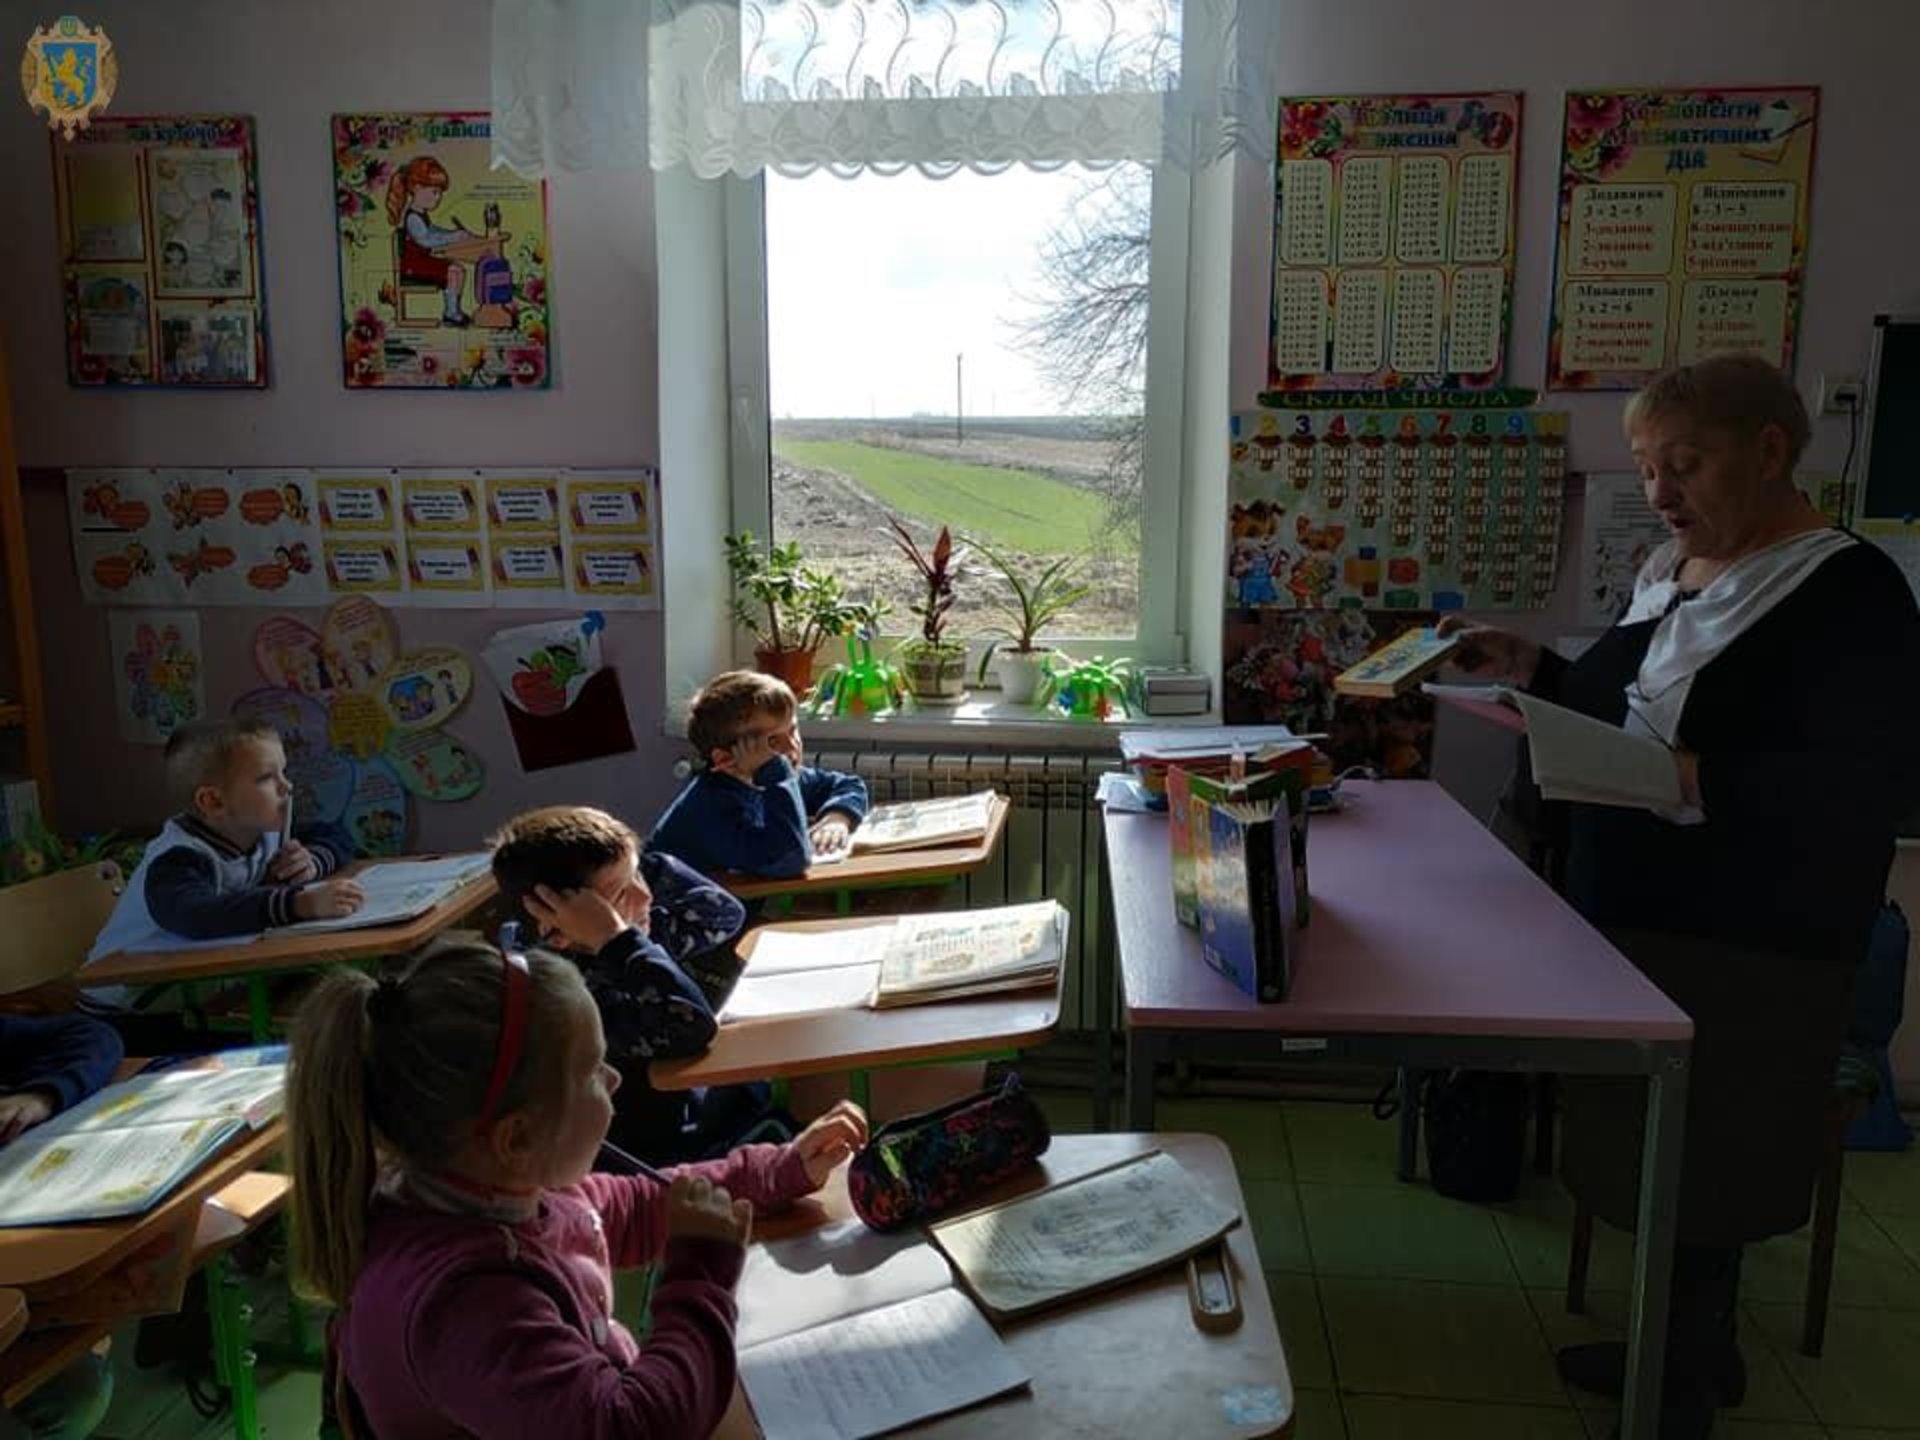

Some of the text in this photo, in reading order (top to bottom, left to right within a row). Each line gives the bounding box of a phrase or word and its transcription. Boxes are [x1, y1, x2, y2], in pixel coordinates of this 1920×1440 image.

[1295, 415, 1311, 434] 3
[1329, 414, 1346, 434] 4
[1401, 415, 1418, 434] 6
[1437, 414, 1453, 434] 7
[1471, 414, 1488, 434] 8
[1507, 415, 1524, 434] 9
